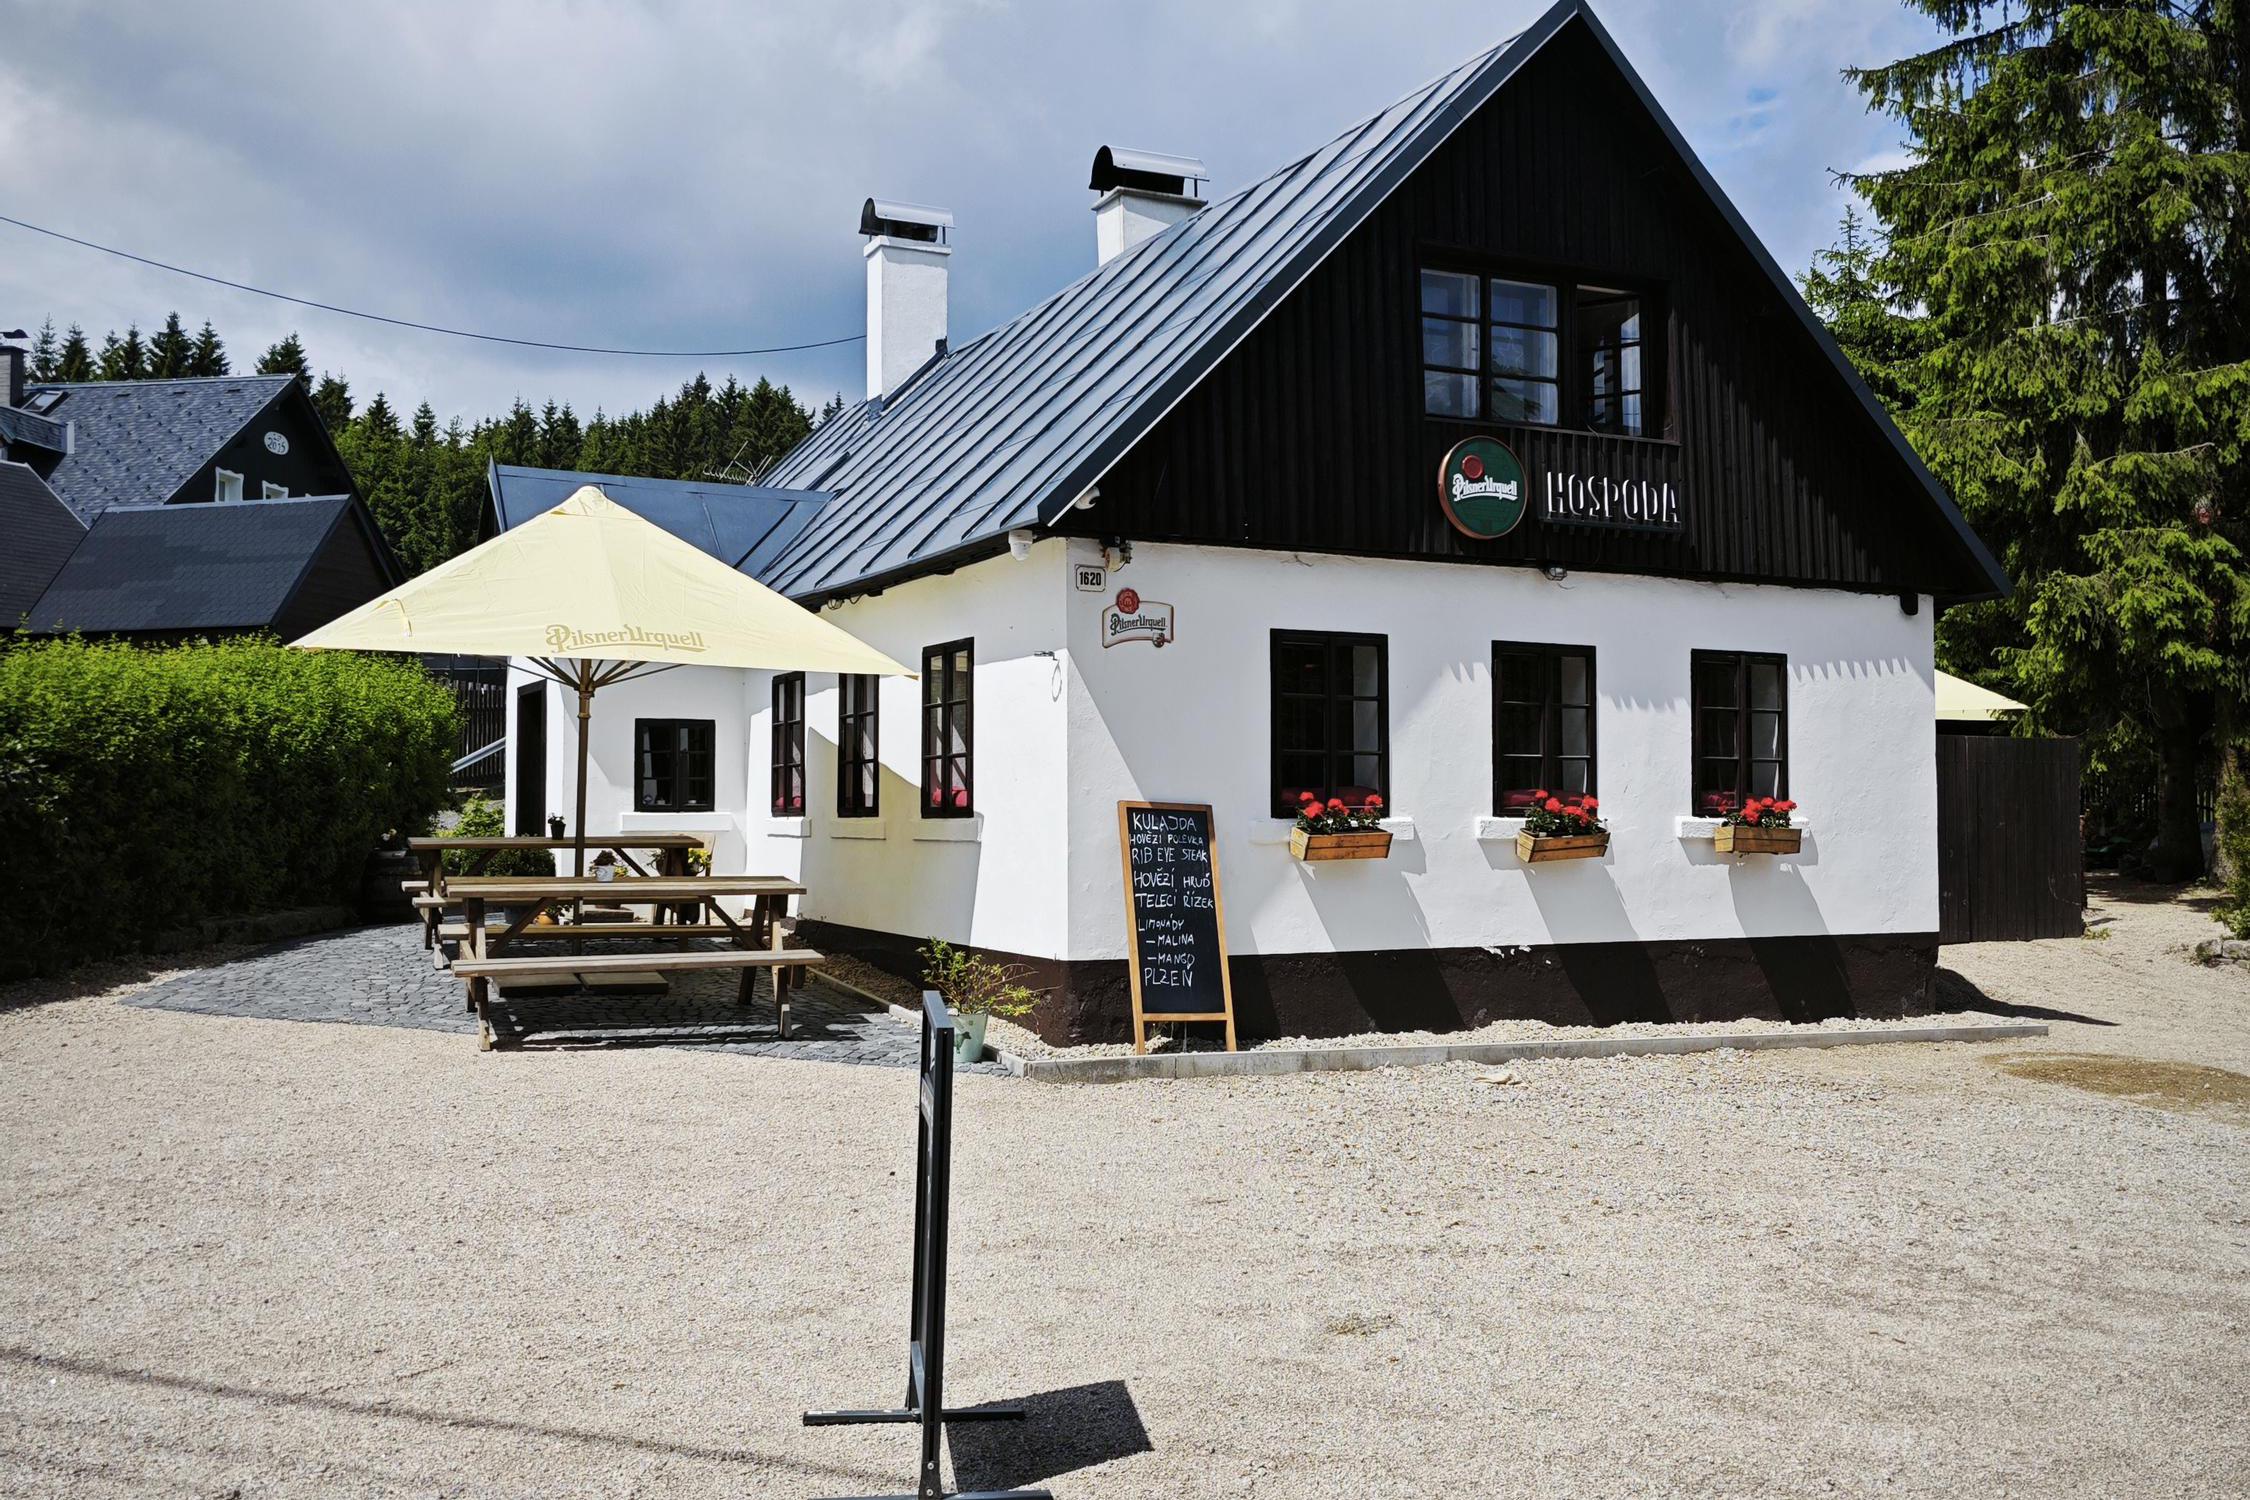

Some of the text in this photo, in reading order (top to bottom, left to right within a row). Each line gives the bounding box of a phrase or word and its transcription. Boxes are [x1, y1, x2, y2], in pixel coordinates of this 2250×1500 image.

[1547, 472, 1680, 523] HOSPODA
[1079, 571, 1102, 586] 1620
[545, 623, 704, 653] Pilsner Urquell
[1132, 812, 1197, 832] KULAJDA
[1131, 846, 1208, 864] RIB EYE STEAK
[1133, 867, 1175, 889] HOVĚZÍ
